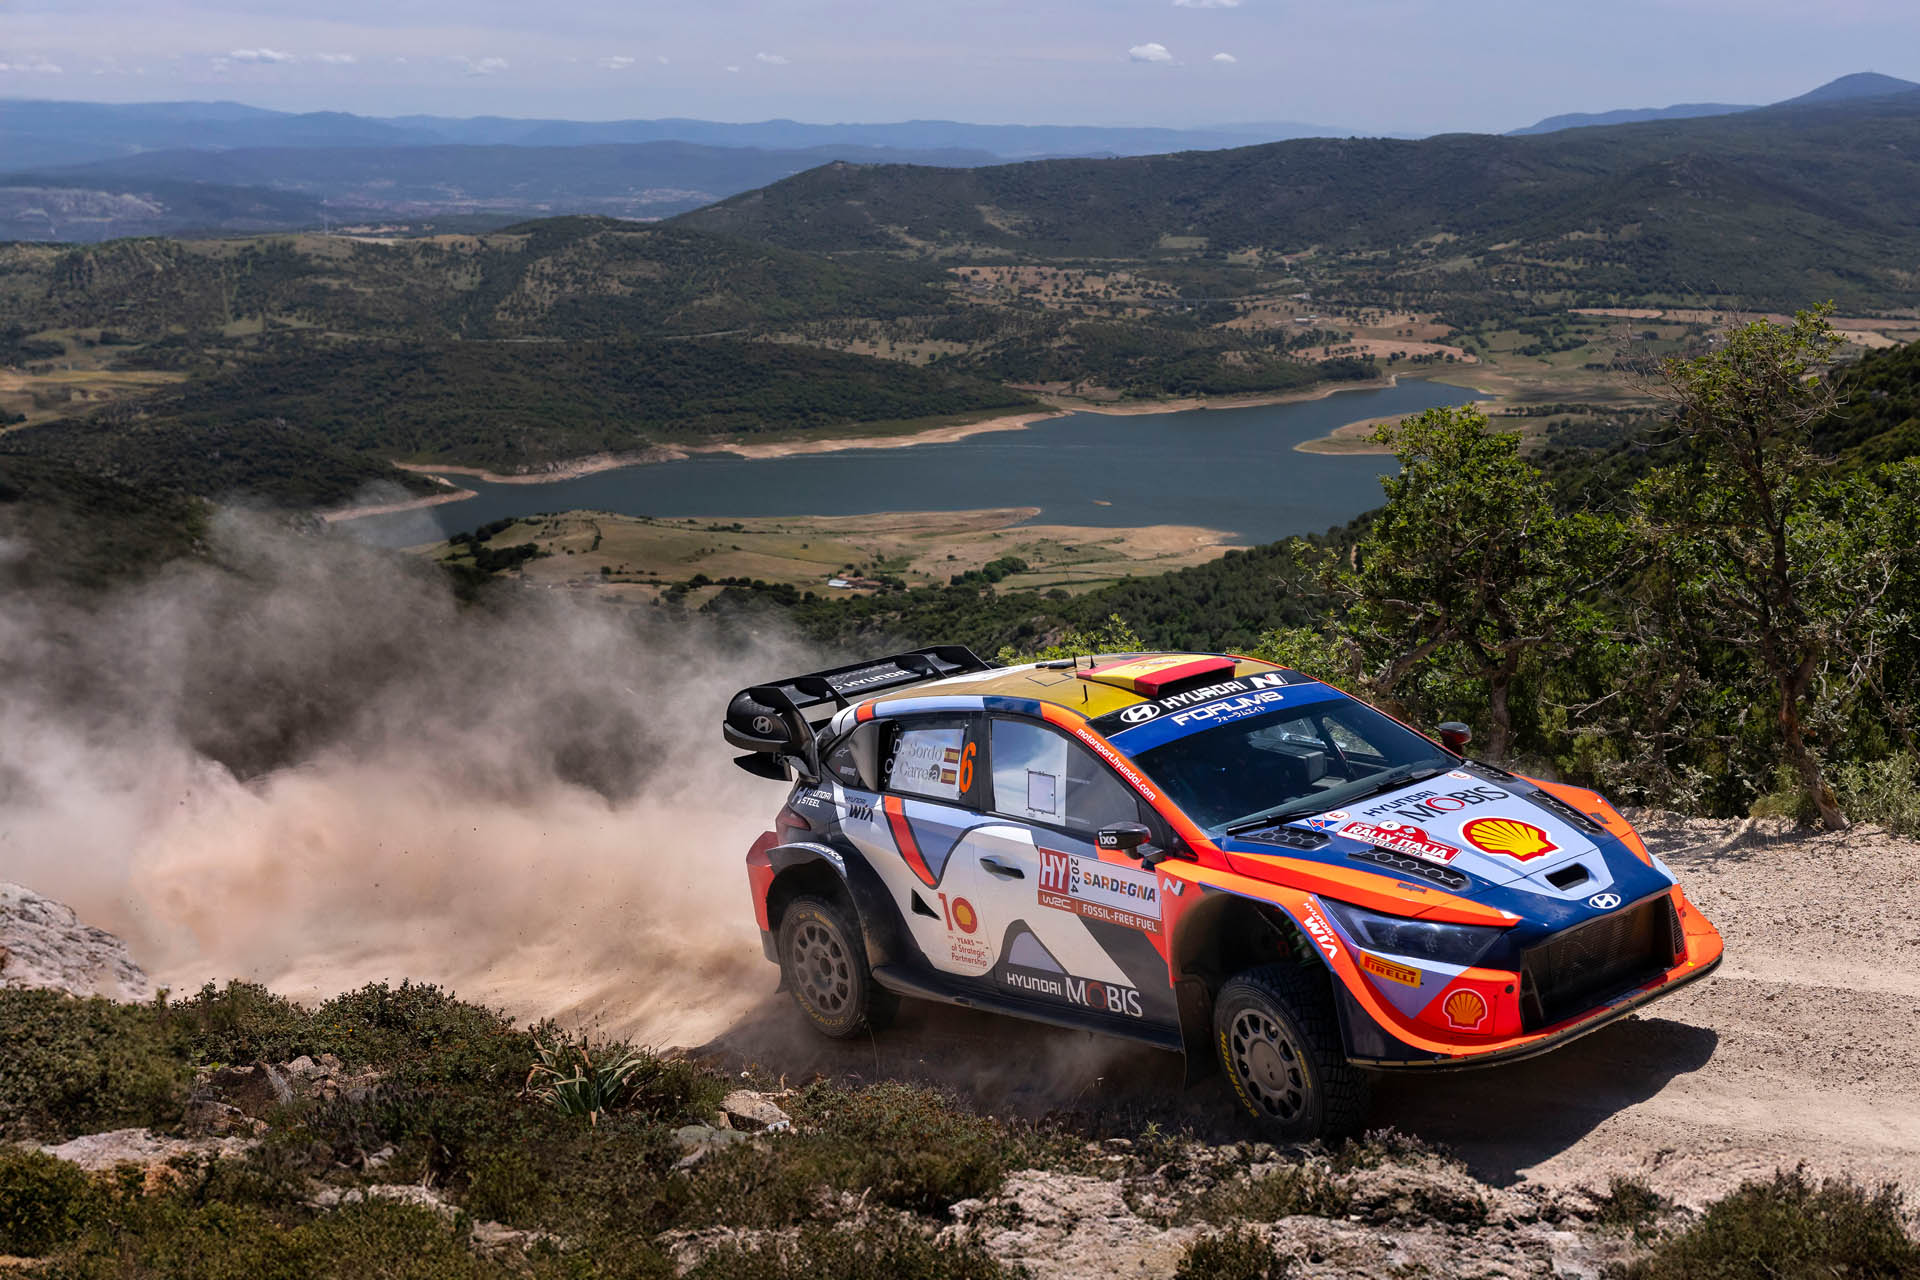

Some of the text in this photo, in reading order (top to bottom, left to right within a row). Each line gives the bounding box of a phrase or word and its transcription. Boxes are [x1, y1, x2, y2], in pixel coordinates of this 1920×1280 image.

[1159, 681, 1249, 709] HYUNDAI
[1171, 691, 1284, 726] FORUM8
[893, 738, 905, 755] D.
[884, 758, 896, 775] C.
[959, 741, 977, 793] 6
[1076, 728, 1157, 801] motorsport.hyundai.com
[801, 796, 820, 808] STEEL
[849, 804, 874, 822] WIA
[1362, 790, 1439, 817] HYUNDAI
[1393, 786, 1509, 823] MOBIS
[1348, 826, 1398, 842] RALLY
[1396, 838, 1448, 860] ITALIA
[1361, 836, 1423, 857] SARDEGNA
[1040, 852, 1067, 890] HY
[1070, 857, 1080, 893] 2024
[1083, 871, 1156, 902] SARDEGNA
[938, 892, 978, 934] 10
[1042, 895, 1072, 910] WRC
[1082, 903, 1158, 932] FOSSIL-FREE FUEL
[1303, 902, 1335, 937] HYUNDAI
[957, 937, 975, 946] YEARS
[958, 945, 985, 957] Strategic
[1303, 915, 1338, 959] WIA
[951, 952, 987, 967] Partnership
[1364, 955, 1417, 984] PIRELLI
[1007, 972, 1143, 1018] HYUNDAI MOBIS
